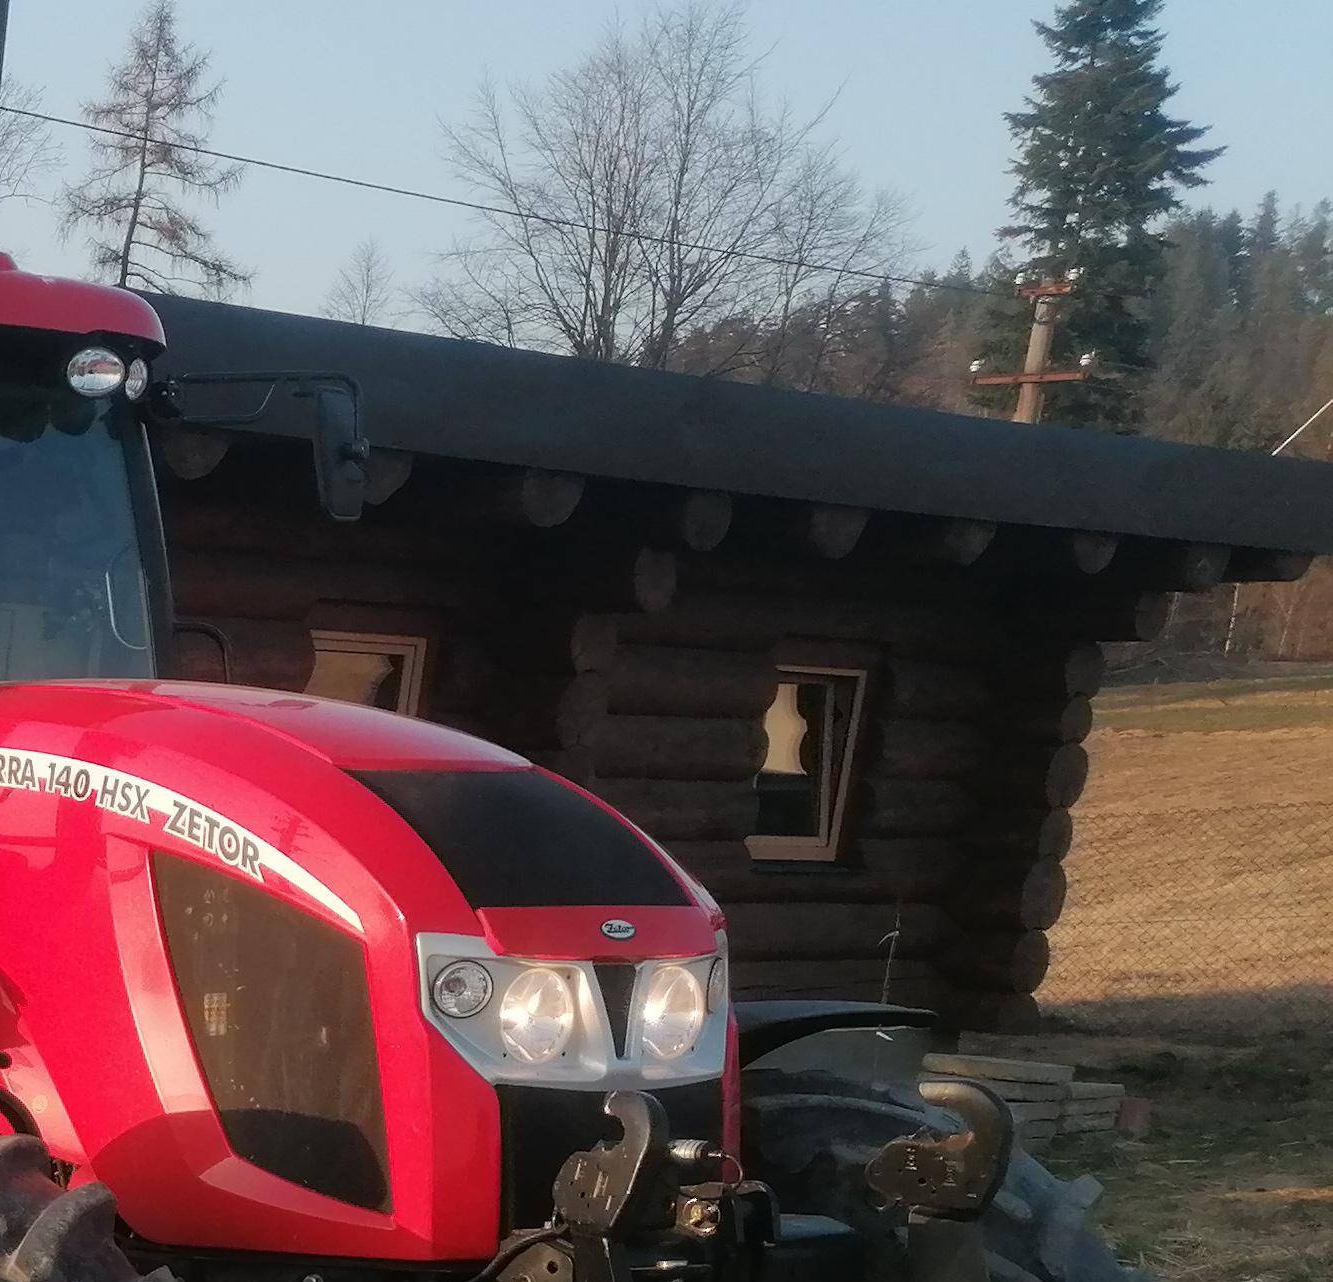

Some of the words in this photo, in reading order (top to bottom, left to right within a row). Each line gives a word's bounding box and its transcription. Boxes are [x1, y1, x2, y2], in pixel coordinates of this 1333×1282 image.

[48, 762, 91, 799] 140
[99, 775, 151, 820] HSX
[167, 800, 260, 877] ZETOR
